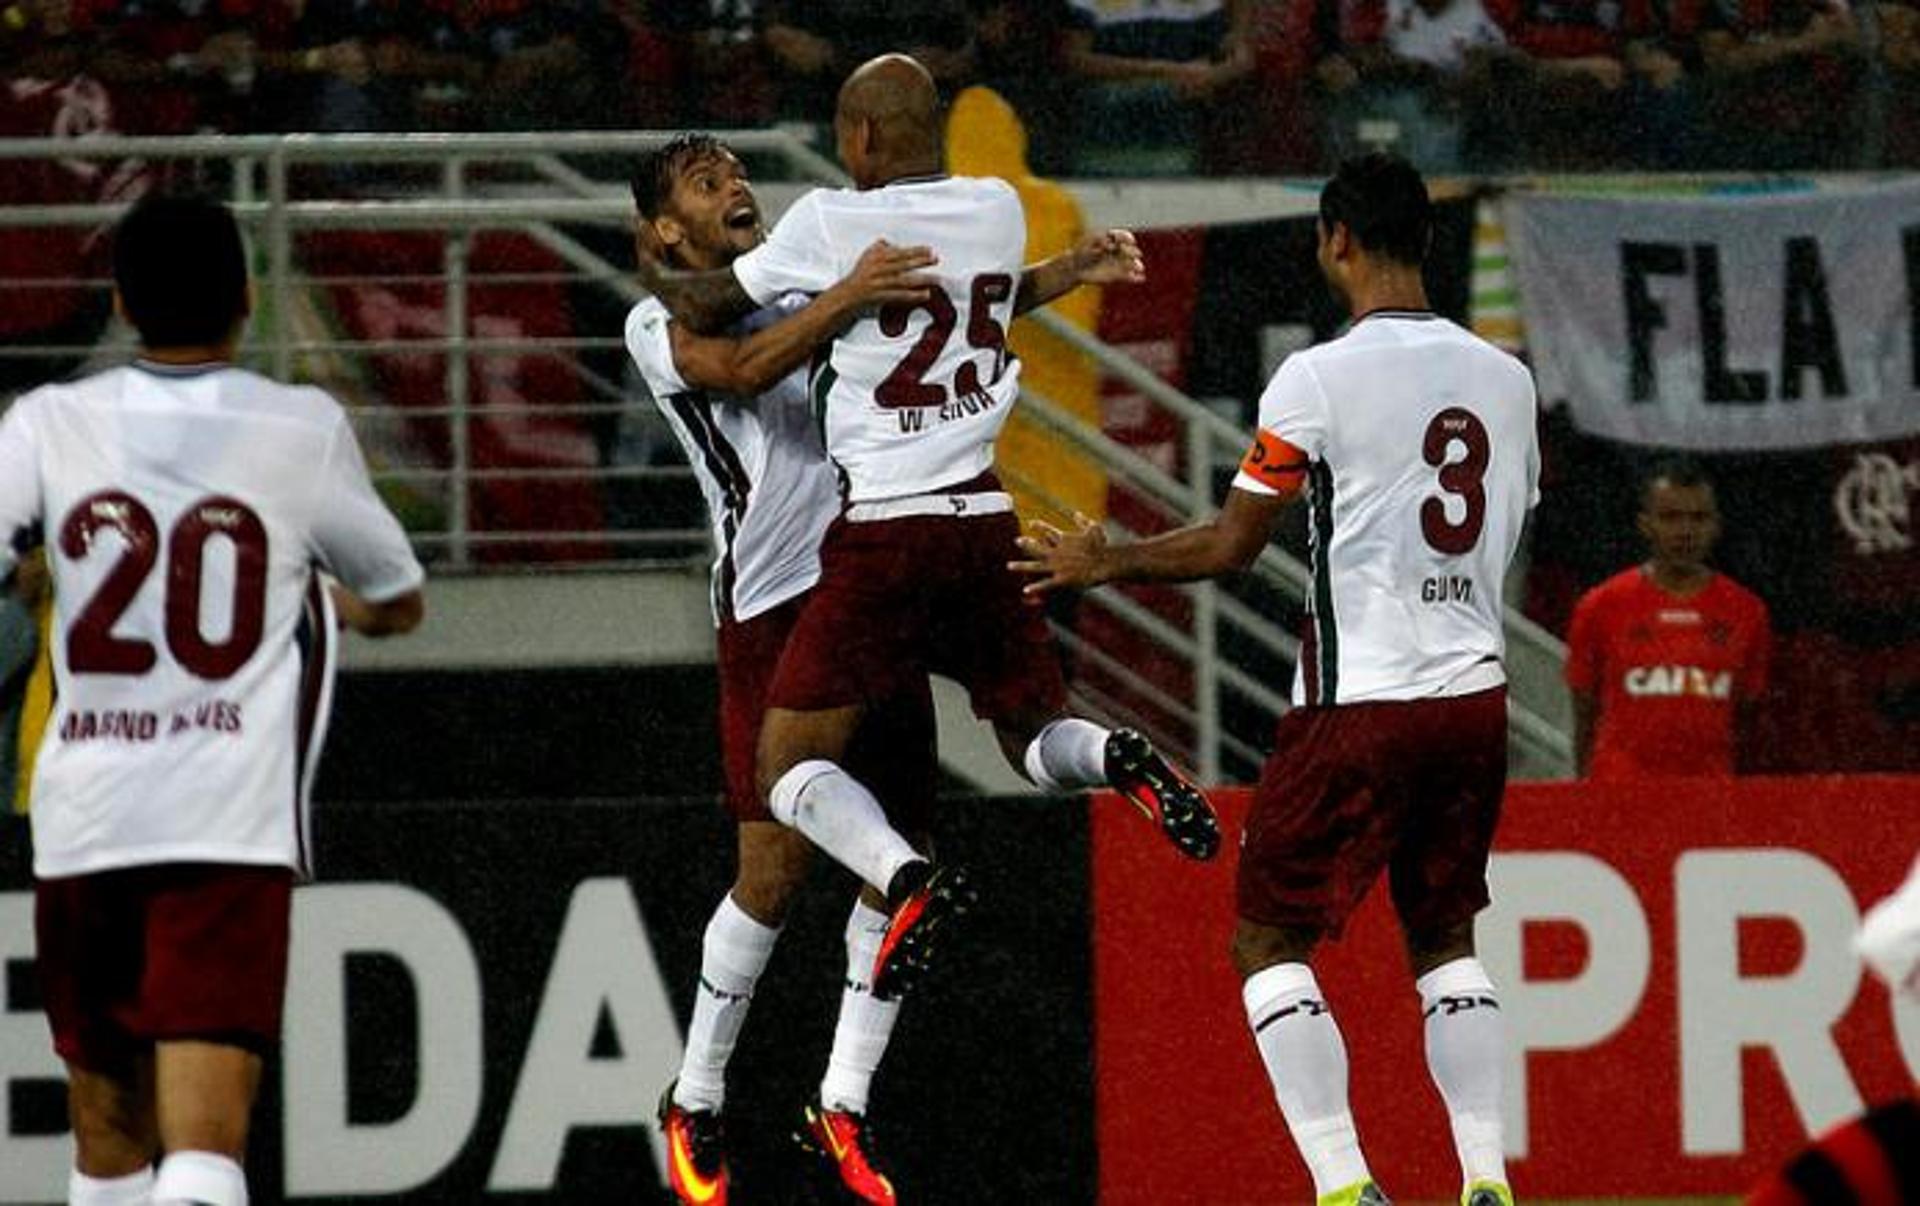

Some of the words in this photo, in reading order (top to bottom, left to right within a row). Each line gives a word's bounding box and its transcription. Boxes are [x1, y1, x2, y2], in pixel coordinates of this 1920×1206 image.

[873, 273, 1013, 409] 25
[1619, 234, 1849, 405] FLA
[1419, 406, 1490, 556] 3
[58, 488, 268, 683] 20
